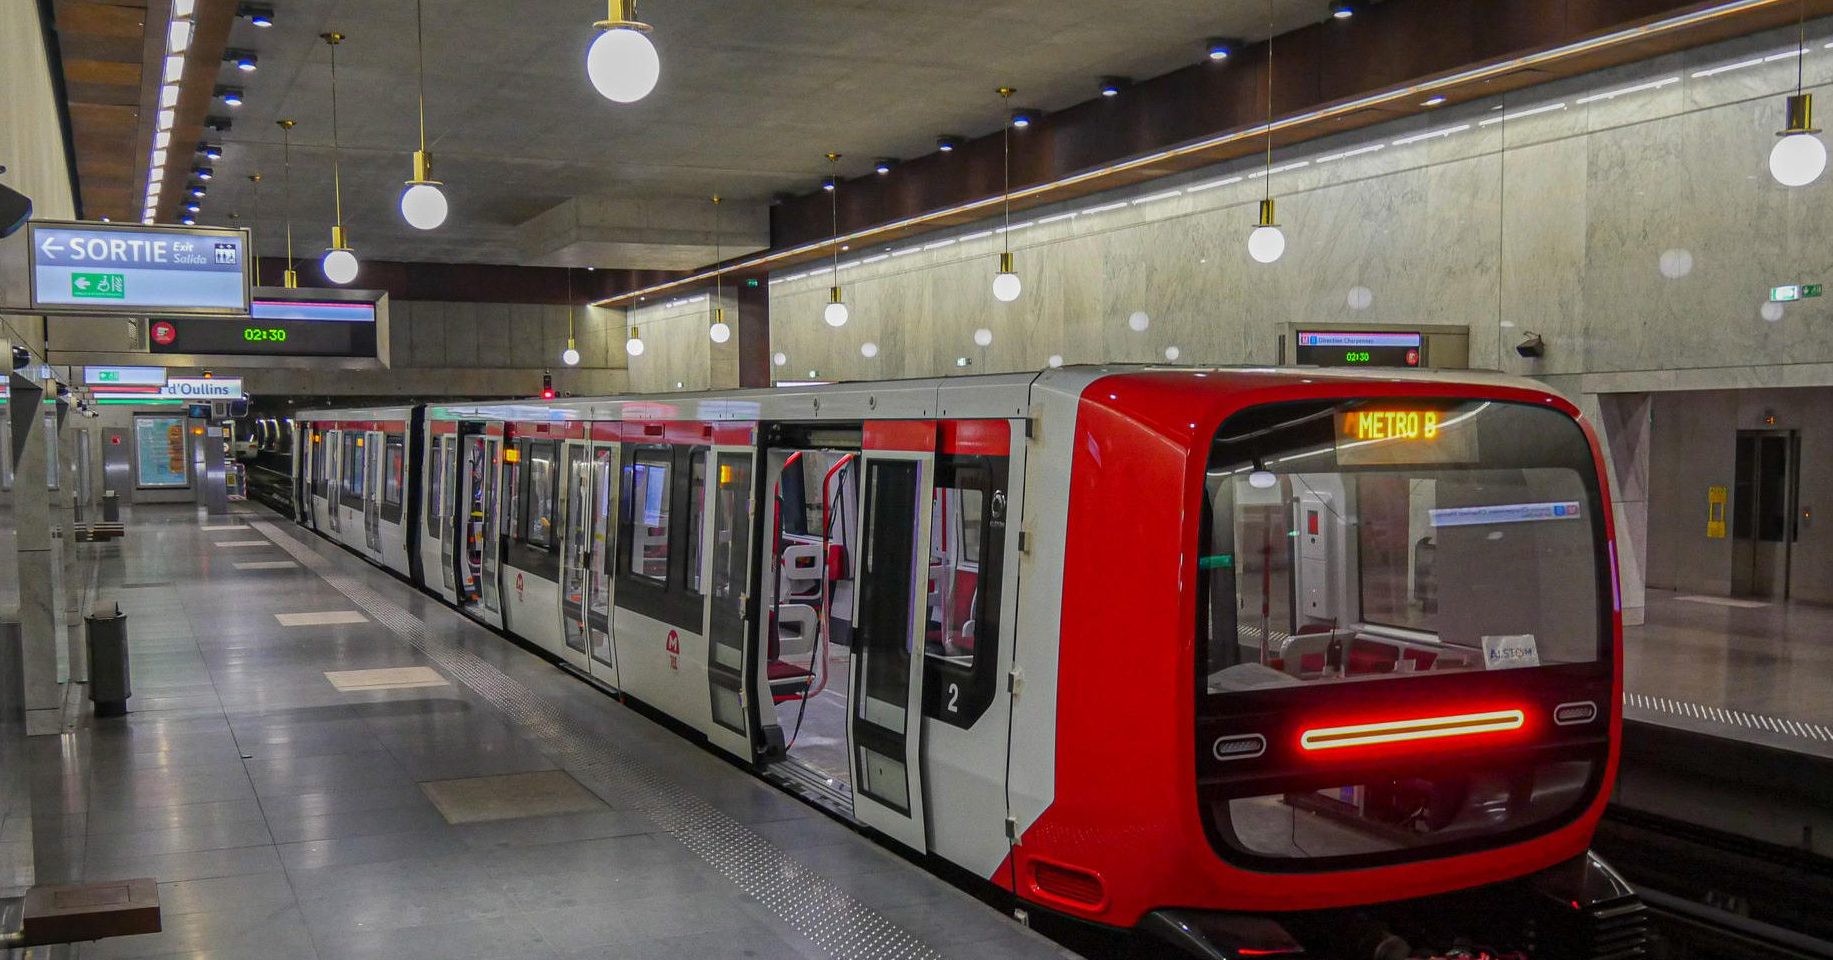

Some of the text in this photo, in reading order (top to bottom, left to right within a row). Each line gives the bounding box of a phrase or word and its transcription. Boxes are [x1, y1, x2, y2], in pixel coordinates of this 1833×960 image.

[69, 237, 194, 263] SORTIE Exit
[173, 253, 207, 265] Salida
[243, 328, 287, 342] 02:30
[1346, 352, 1369, 362] 02:30
[168, 383, 229, 395] d'Oullins
[1359, 411, 1437, 439] METRO B
[947, 682, 959, 713] 2
